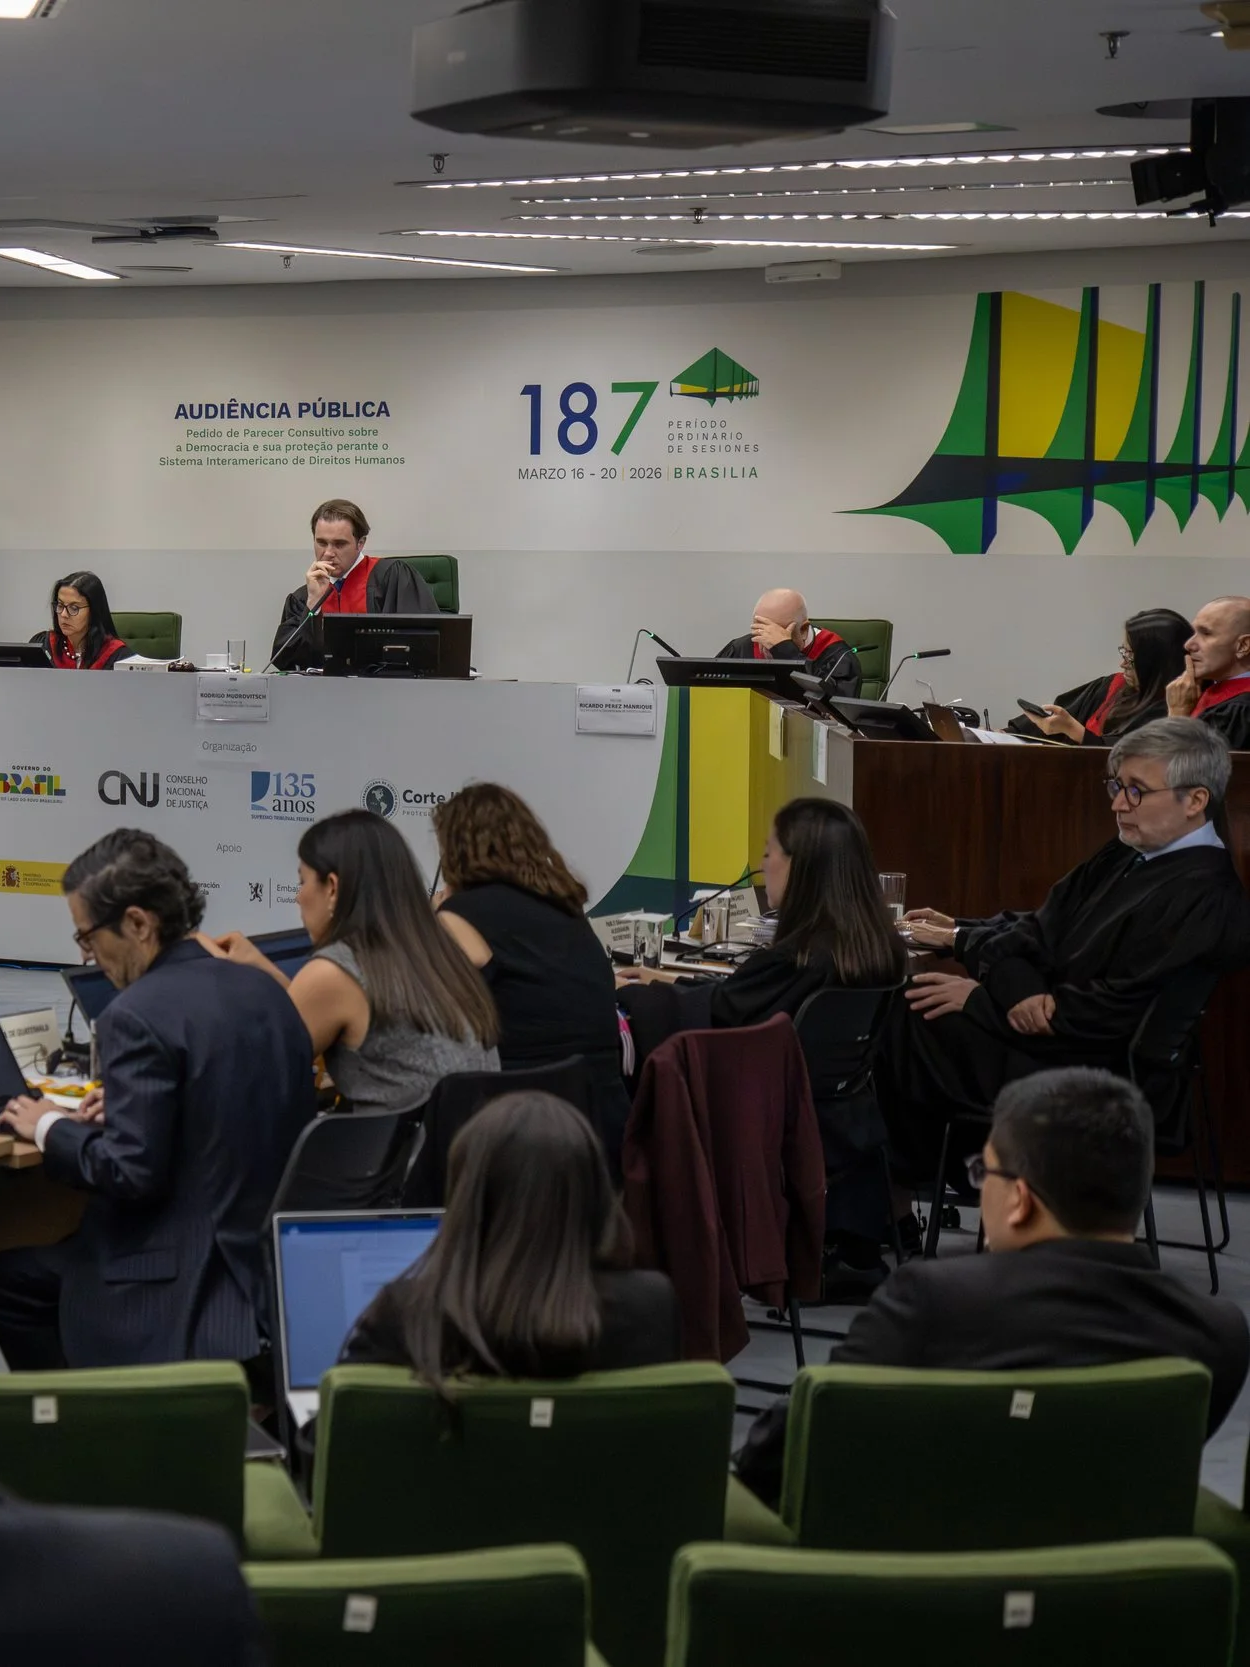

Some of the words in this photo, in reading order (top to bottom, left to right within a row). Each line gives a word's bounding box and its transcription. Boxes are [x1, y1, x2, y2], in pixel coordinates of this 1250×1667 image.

[174, 397, 292, 419] AUDIÊNCIA
[298, 396, 391, 418] PÚBLICA
[519, 381, 660, 456] 187
[668, 417, 727, 429] PERÍODO
[186, 427, 223, 438] Pedido
[226, 428, 240, 438] de
[243, 427, 284, 438] Parecer
[287, 427, 345, 438] Consultivo
[348, 426, 379, 437] sobre
[667, 431, 743, 442] ORDINARIO
[176, 444, 183, 452] a
[186, 442, 250, 452] Democracia
[252, 444, 259, 452] e
[262, 444, 281, 452] sua
[285, 442, 333, 454] proteção
[336, 441, 379, 453] perante
[667, 445, 684, 454] DE
[692, 443, 760, 453] SESIONES
[159, 456, 203, 466] Sistema
[206, 456, 288, 466] Interamericano
[292, 456, 306, 465] de
[309, 455, 351, 465] Direitos
[354, 455, 406, 465] Humanos
[518, 467, 567, 480] MARZO
[570, 467, 585, 479] 16
[600, 467, 617, 479] 20
[629, 467, 662, 479] 2026
[673, 466, 759, 479] BRASILIA
[201, 740, 258, 754] Organização
[166, 774, 208, 785] CONSELHO
[272, 772, 316, 798] 135
[97, 769, 160, 808] CNJ
[166, 787, 206, 797] NACIONAL
[402, 789, 445, 805] Corte
[166, 799, 176, 808] DE
[178, 800, 208, 811] JUSTIÇA
[272, 798, 316, 814] anos
[215, 842, 243, 854] Apoio
